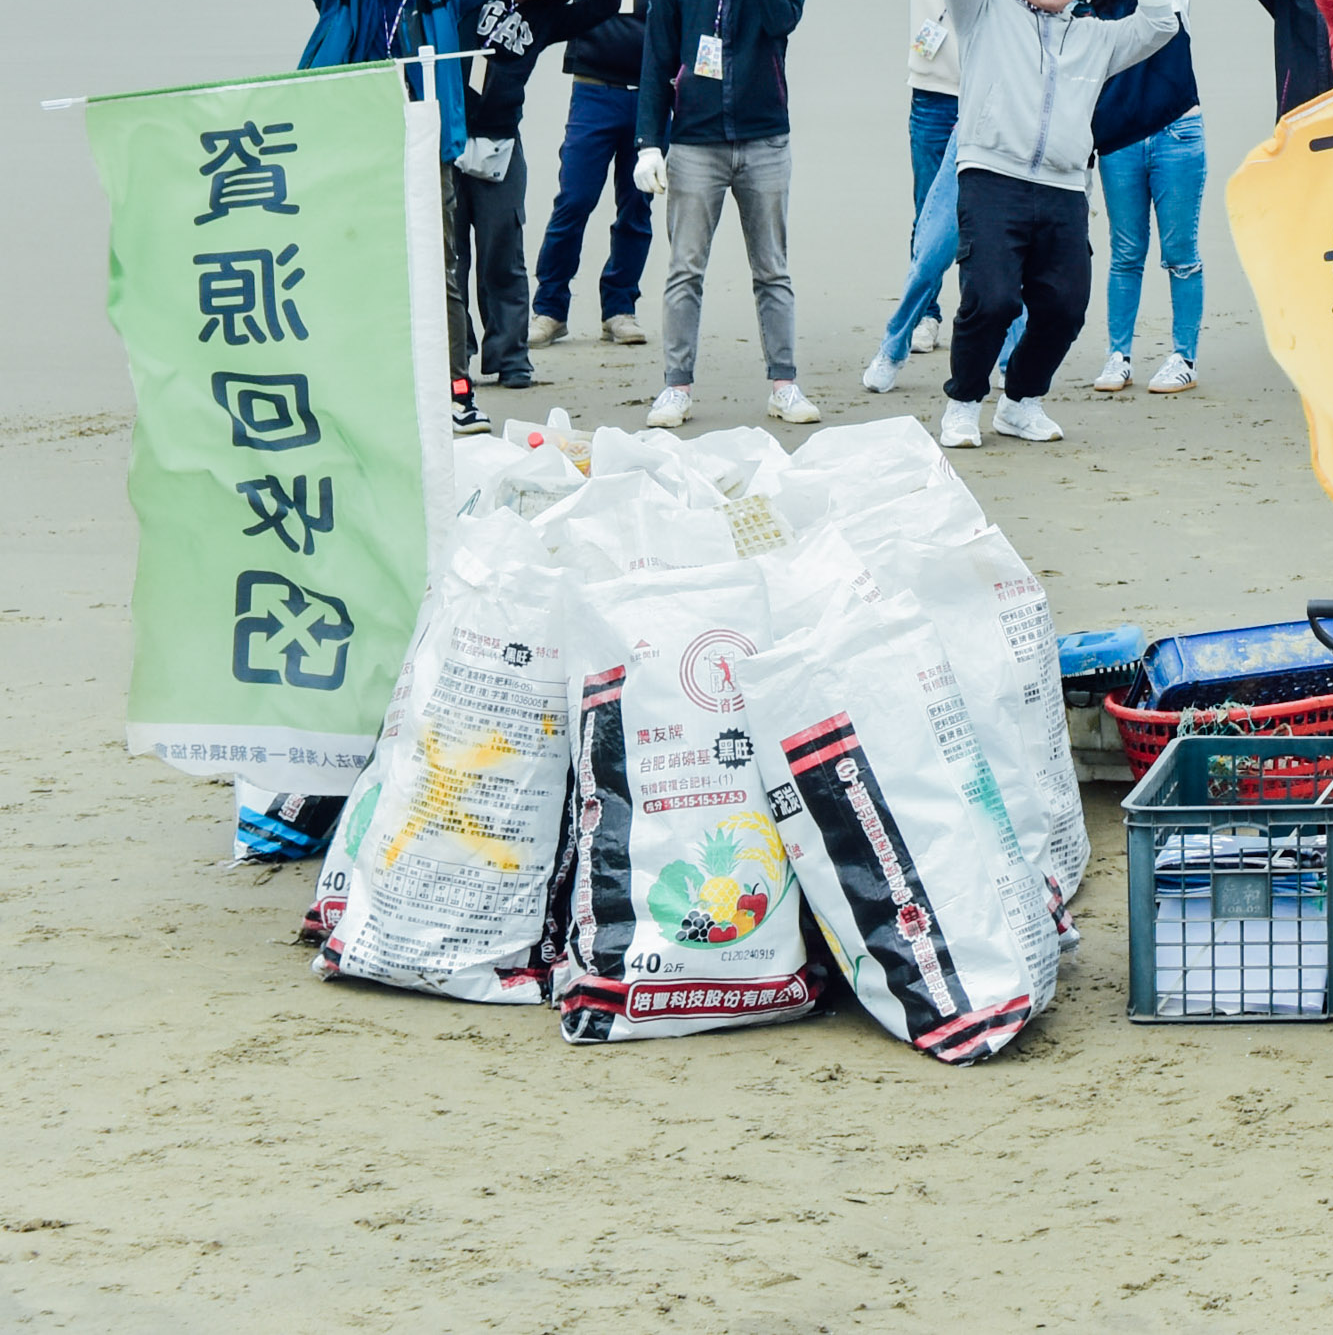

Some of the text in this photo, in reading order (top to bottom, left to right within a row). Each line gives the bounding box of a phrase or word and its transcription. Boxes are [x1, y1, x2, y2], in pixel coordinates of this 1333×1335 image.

[476, 0, 534, 57] GAP
[636, 724, 684, 746] 農友牌
[717, 738, 752, 762] 黑旺
[321, 871, 346, 892] 40
[631, 952, 684, 974] 40 公斤
[632, 981, 805, 1012] 培豐科技股份有限公司
